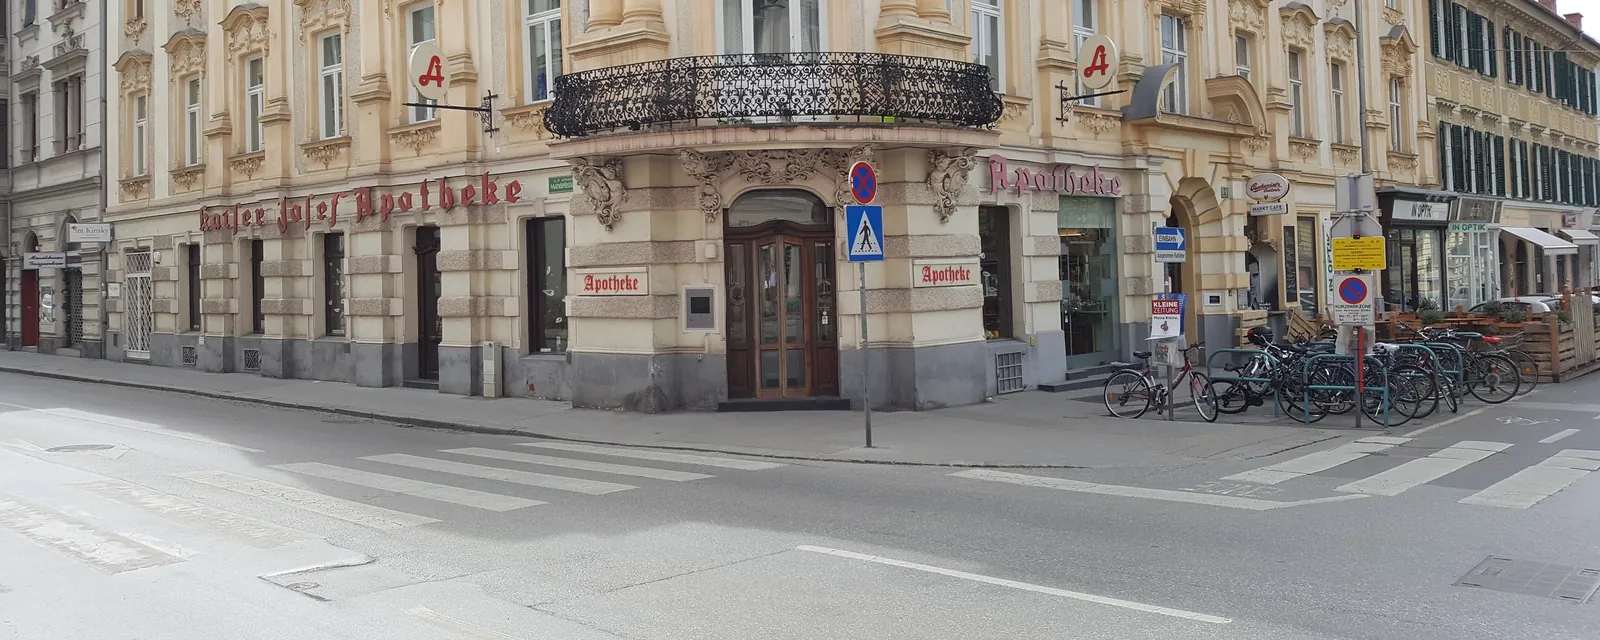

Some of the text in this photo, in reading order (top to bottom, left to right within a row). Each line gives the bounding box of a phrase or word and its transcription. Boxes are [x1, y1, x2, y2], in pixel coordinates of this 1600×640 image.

[418, 55, 445, 88] A
[1083, 44, 1110, 78] A
[988, 154, 1121, 198] Apotheke
[354, 171, 522, 223] Apotheke
[1461, 223, 1486, 231] OPTIK
[583, 274, 639, 294] Apotheke
[921, 265, 971, 285] Apotheke
